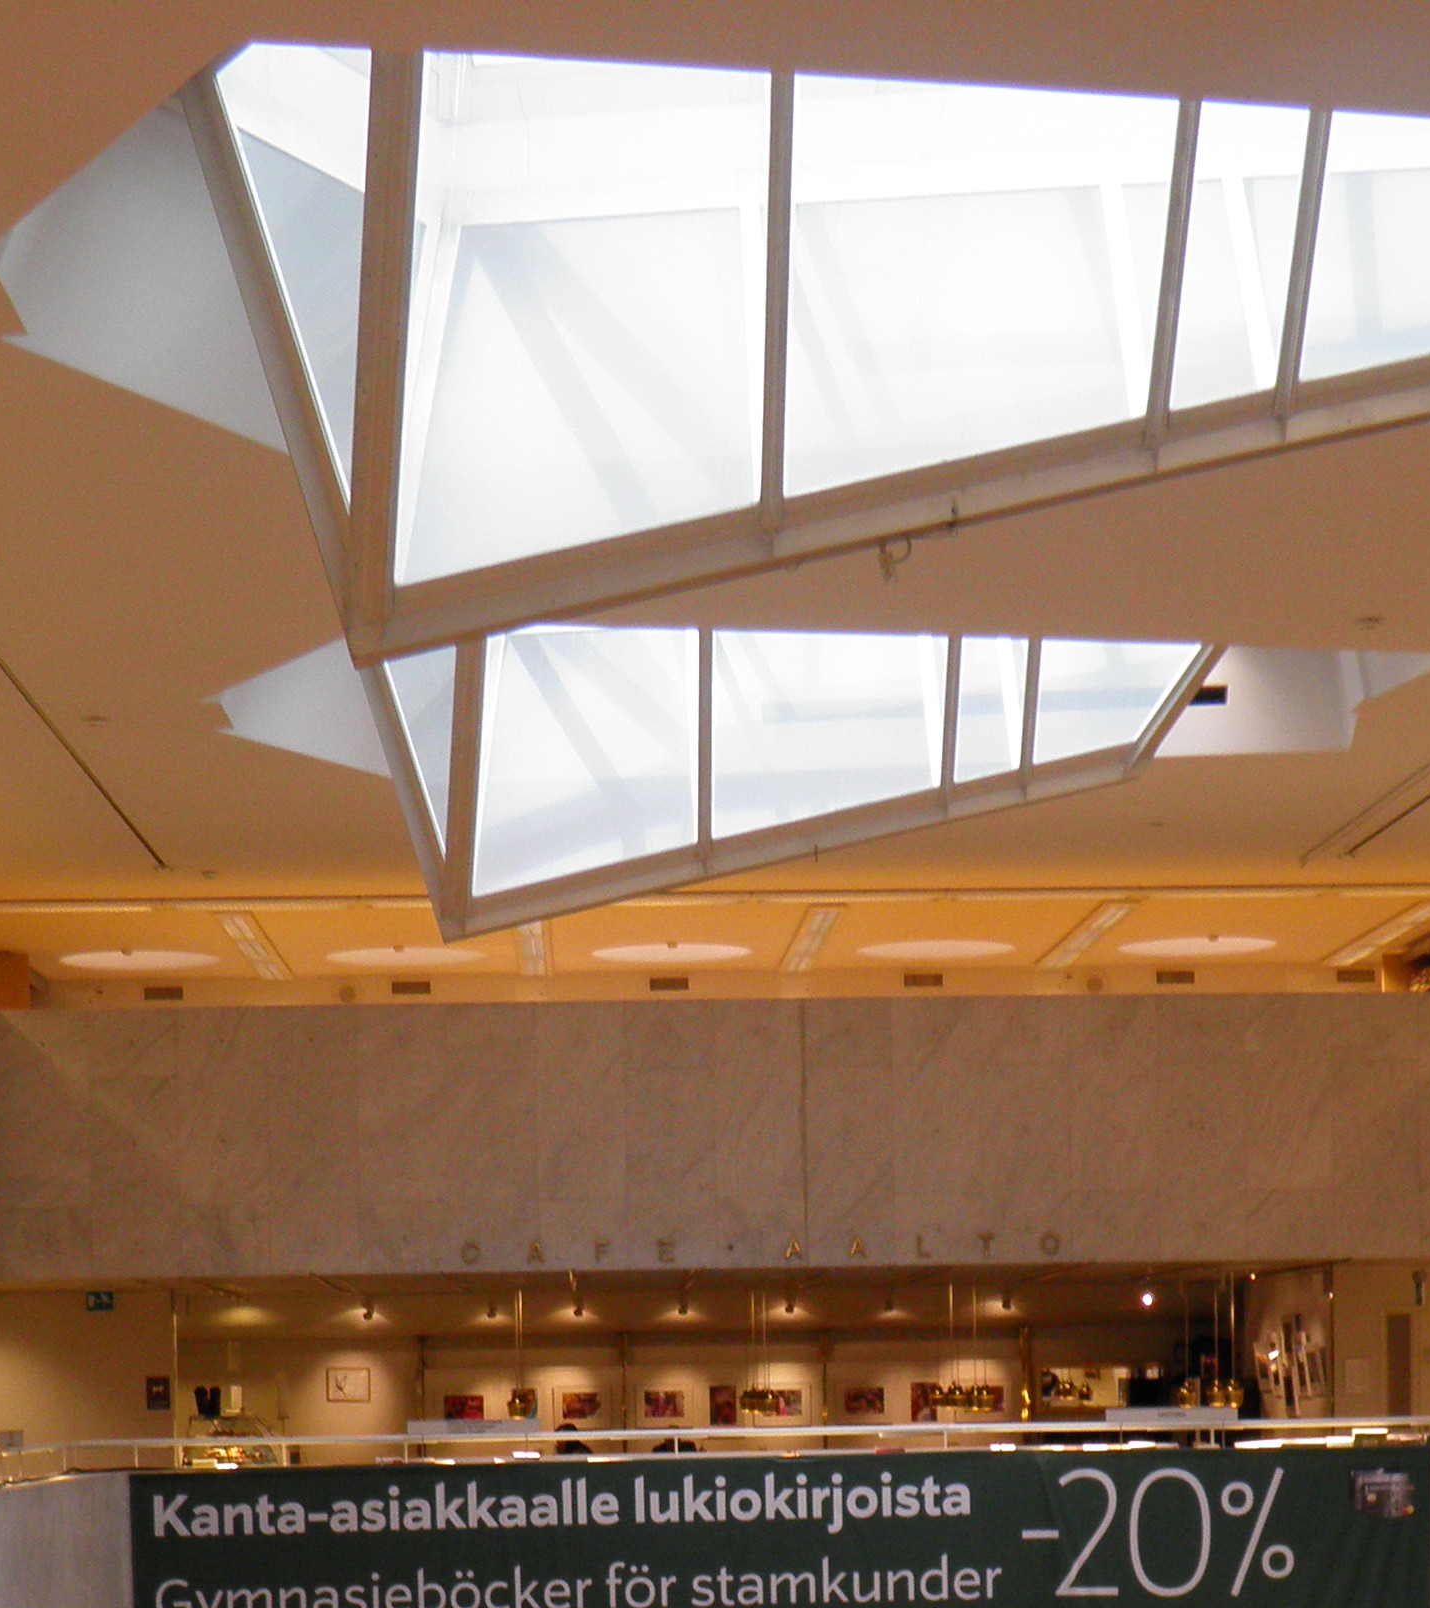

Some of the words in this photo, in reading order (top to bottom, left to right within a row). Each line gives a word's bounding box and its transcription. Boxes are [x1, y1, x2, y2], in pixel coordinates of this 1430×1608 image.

[784, 1232, 1061, 1260] AALTO
[154, 1477, 620, 1537] Kanta-asiakkaalle
[635, 1470, 971, 1534] lukiokirjoista
[1021, 1466, 1295, 1598] -20%
[607, 1561, 677, 1608] för
[691, 1553, 1002, 1607] stamkunder
